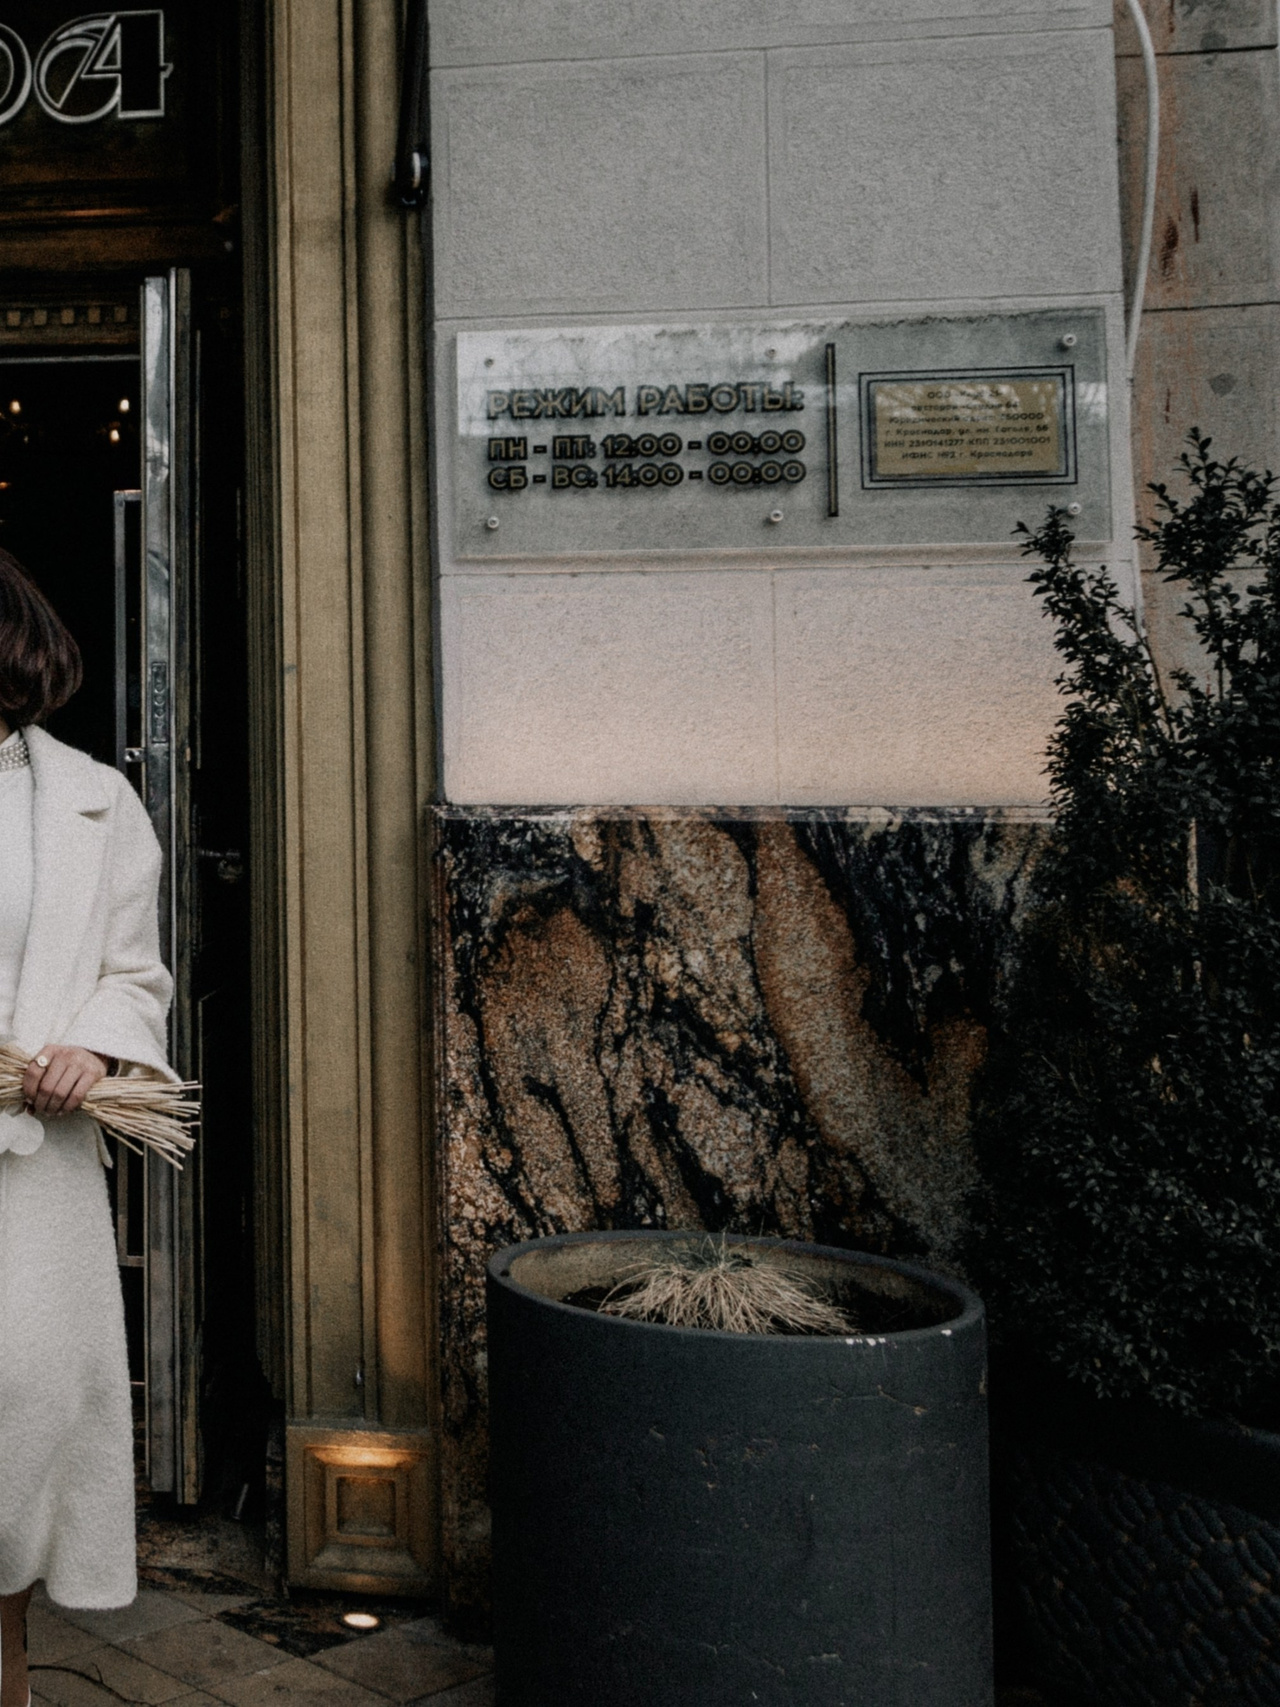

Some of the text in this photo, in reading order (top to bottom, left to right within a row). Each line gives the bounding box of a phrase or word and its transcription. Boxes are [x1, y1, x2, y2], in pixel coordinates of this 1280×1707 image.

[486, 381, 805, 419] РЕЖИМ РАБОТЫ:
[488, 436, 528, 460] ПН
[552, 434, 597, 460] ПТ:
[603, 432, 682, 459] 12:00
[708, 430, 806, 456] 00:00
[968, 437, 990, 446] КПП
[488, 465, 528, 490] СБ
[552, 464, 598, 489] ВС:
[603, 462, 684, 487] 14:00
[708, 460, 806, 485] 00:00
